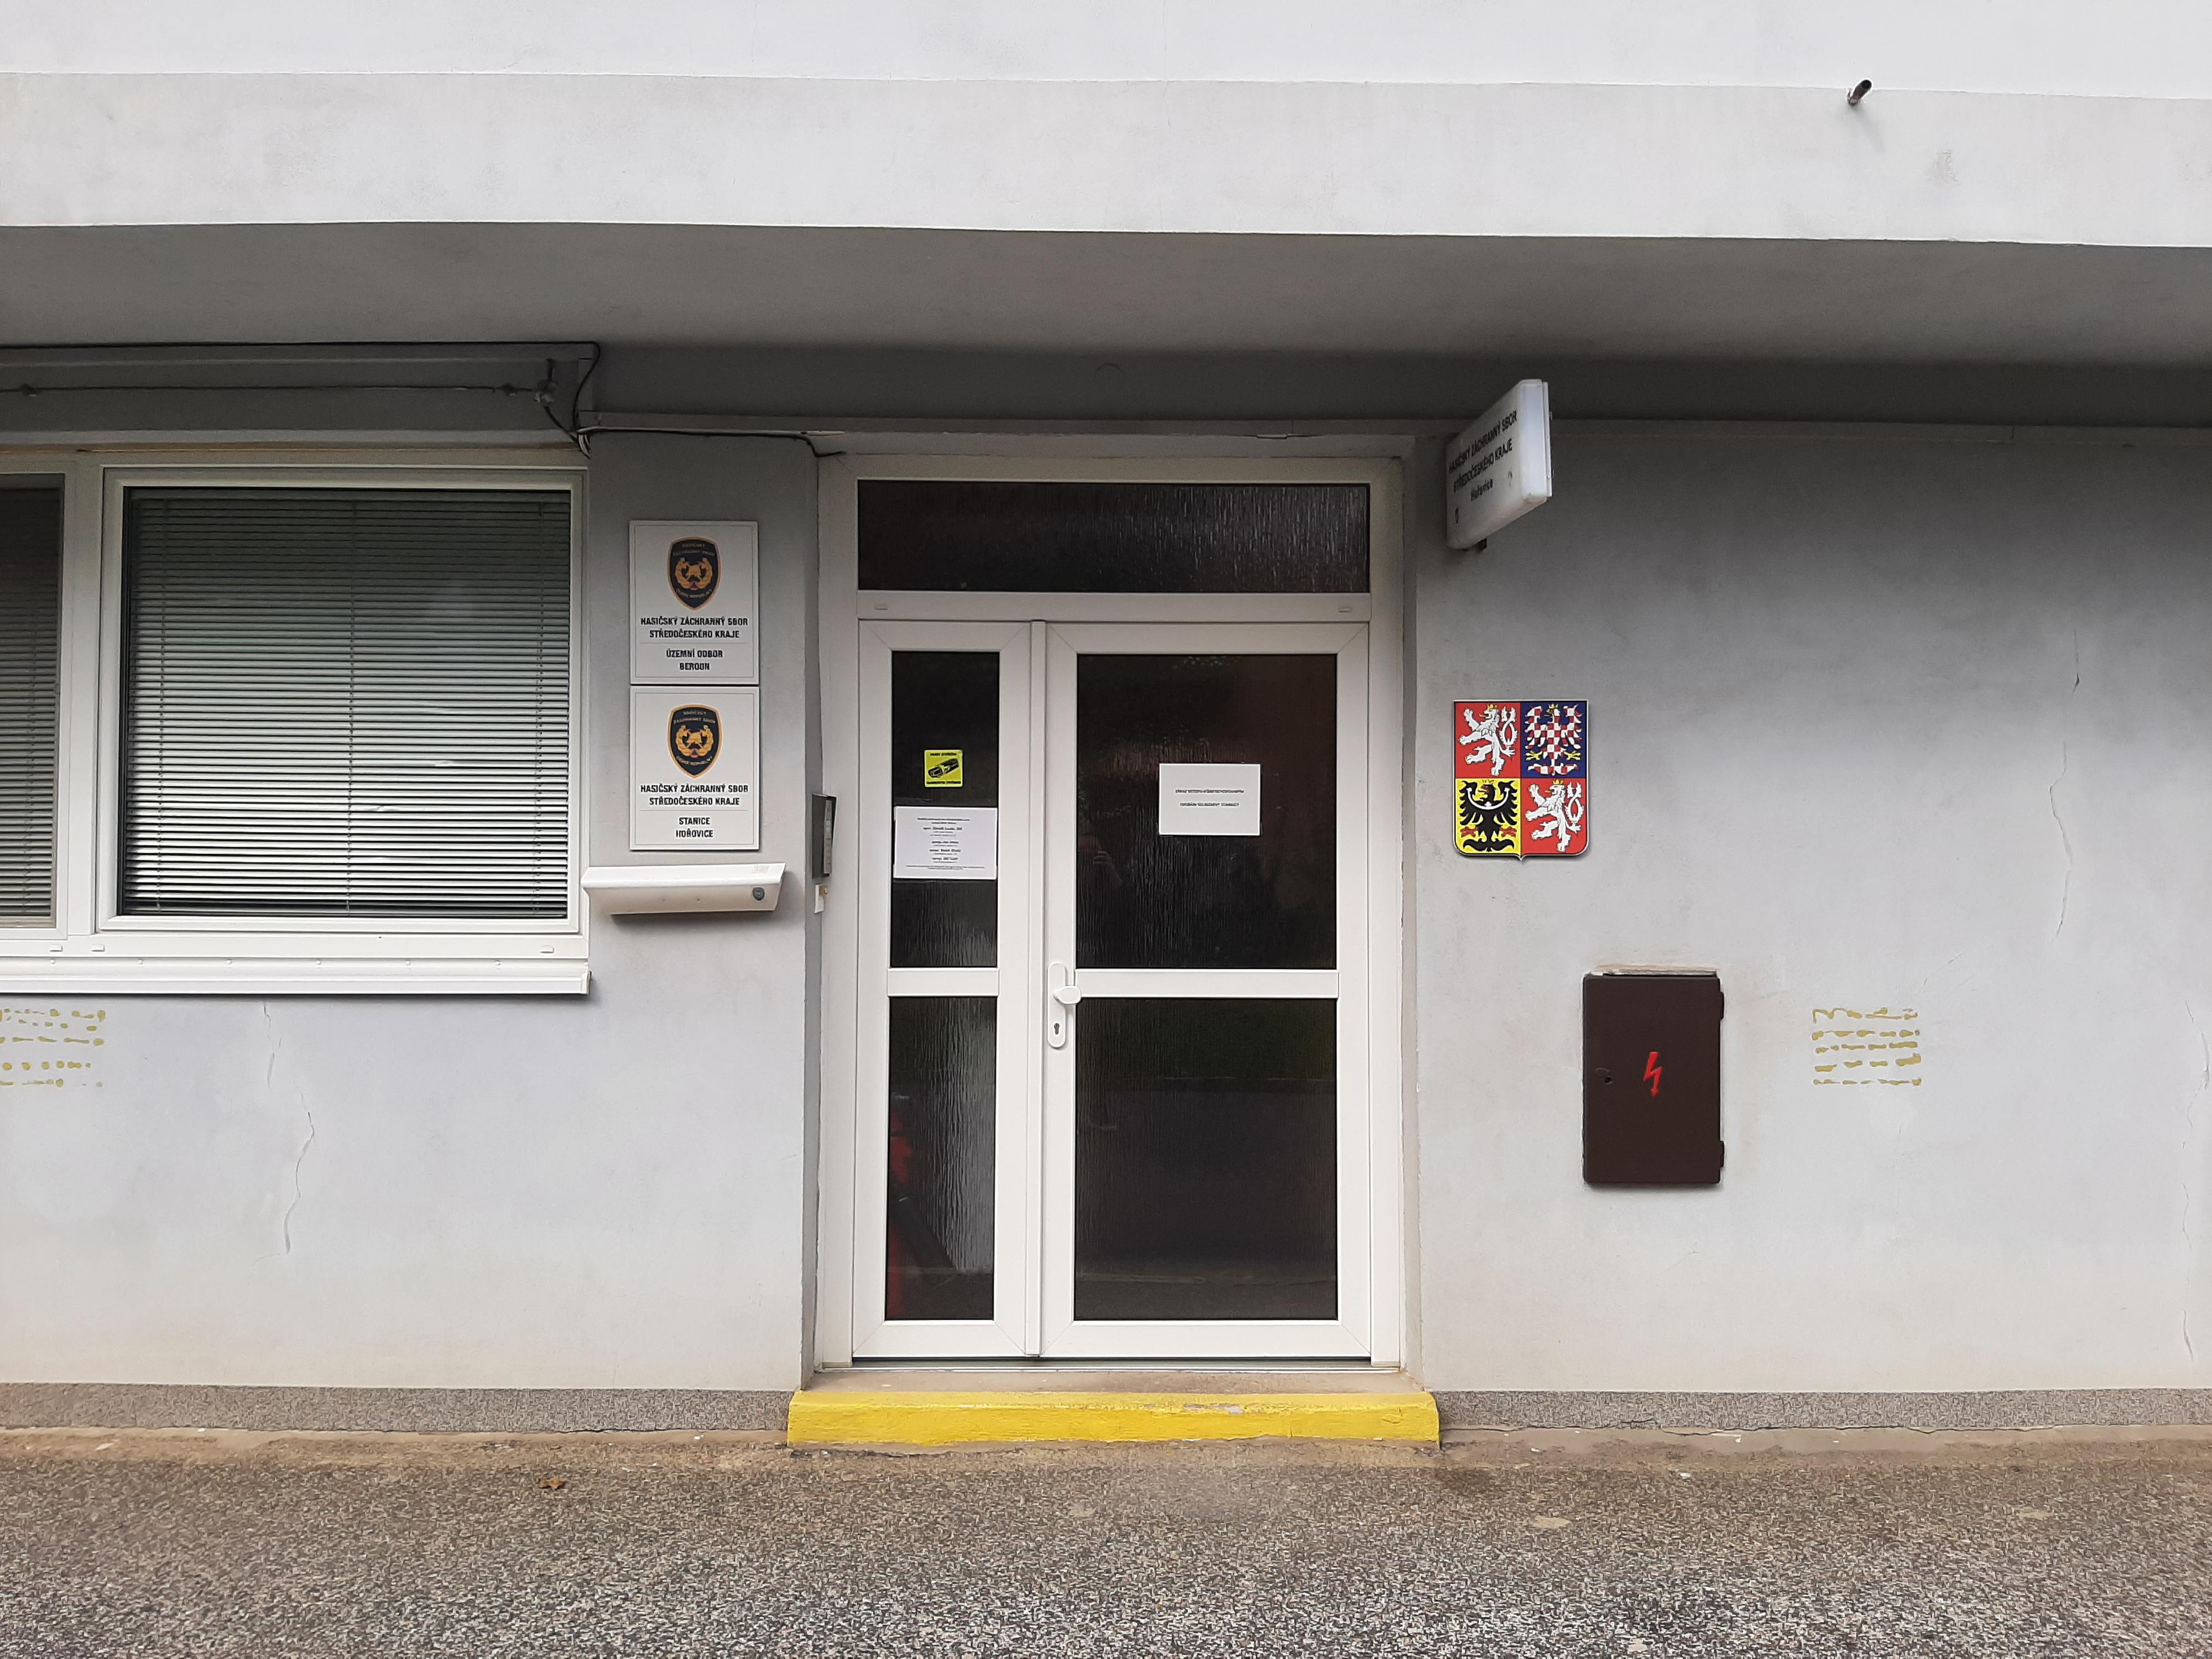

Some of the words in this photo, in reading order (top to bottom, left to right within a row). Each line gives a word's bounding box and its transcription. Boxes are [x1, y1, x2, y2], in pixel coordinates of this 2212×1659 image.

[1501, 409, 1517, 432] SBOR
[1495, 438, 1513, 461] KRAJE
[640, 616, 677, 625] HASIČSKÝ
[680, 616, 726, 626] ZÁCHRANNÝ
[649, 629, 712, 638] STŘEDOČESKÉHO
[715, 630, 739, 638] KRAJE
[666, 648, 695, 658] ÚZEMNÍ
[640, 783, 677, 792] HASIČSKÝ
[680, 783, 726, 792] ZÁCHRANNÝ
[649, 796, 712, 805] STŘEDOČESKÉHO
[676, 828, 714, 838] HOŘOVICE
